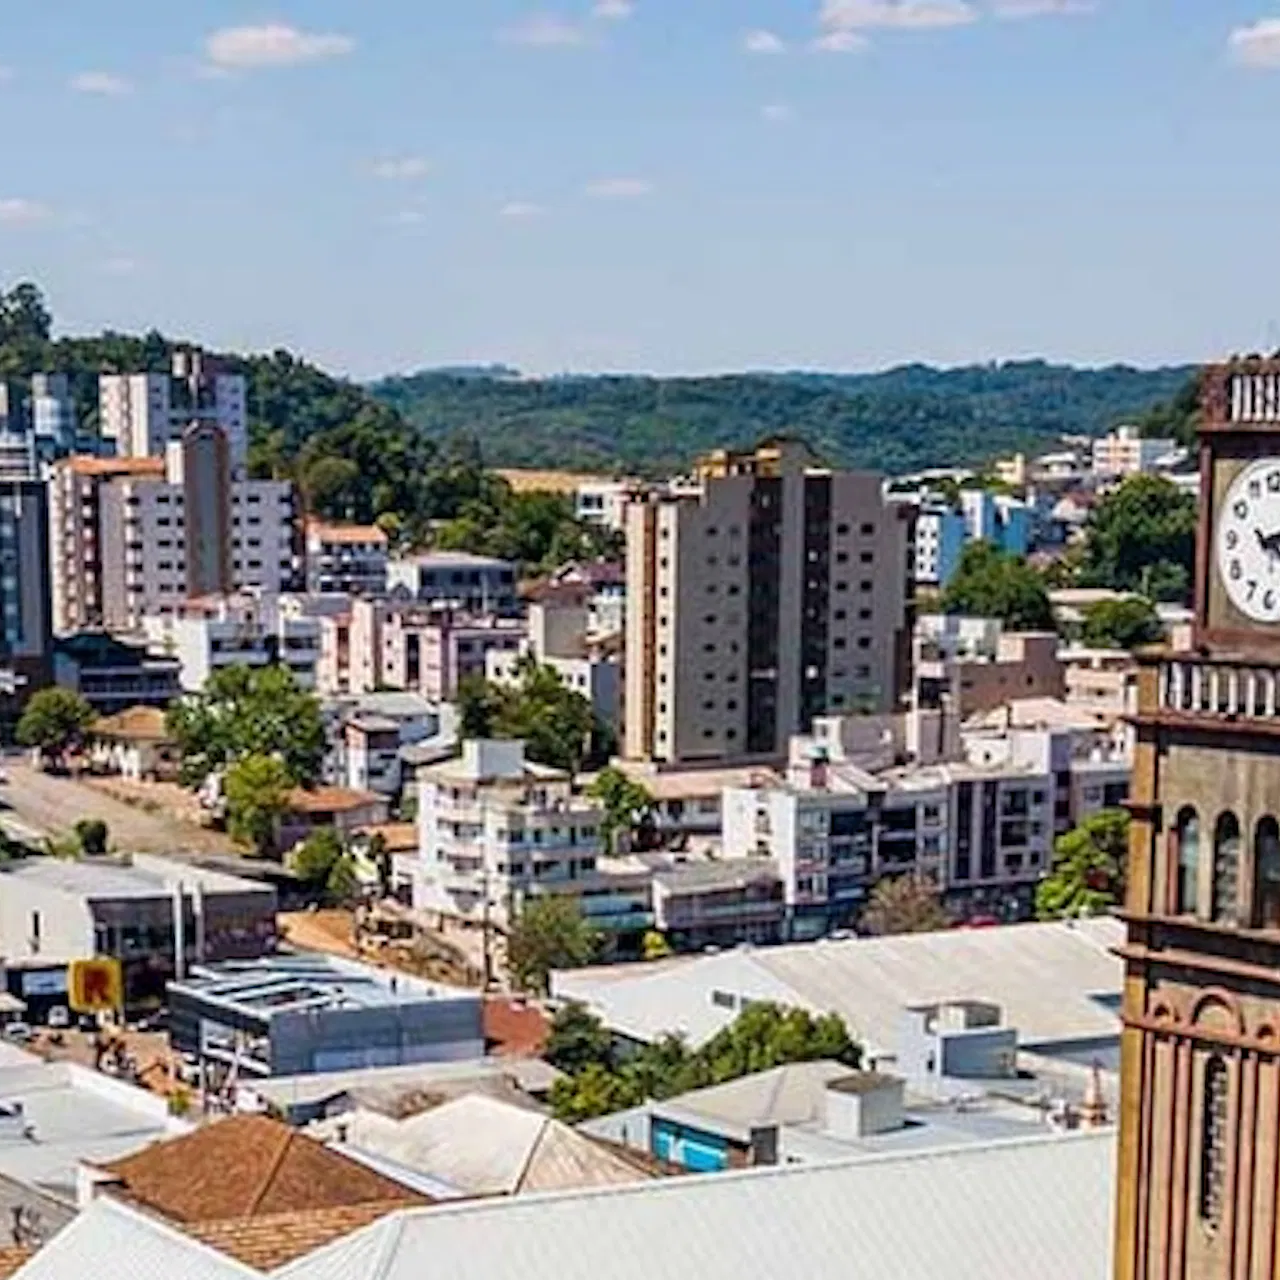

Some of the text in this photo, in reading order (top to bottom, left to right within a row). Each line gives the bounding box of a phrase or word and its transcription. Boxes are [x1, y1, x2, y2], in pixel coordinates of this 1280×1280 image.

[1226, 529, 1237, 550] 9
[1230, 559, 1241, 580] 8
[1246, 580, 1257, 601] 7
[1263, 589, 1275, 610] 6
